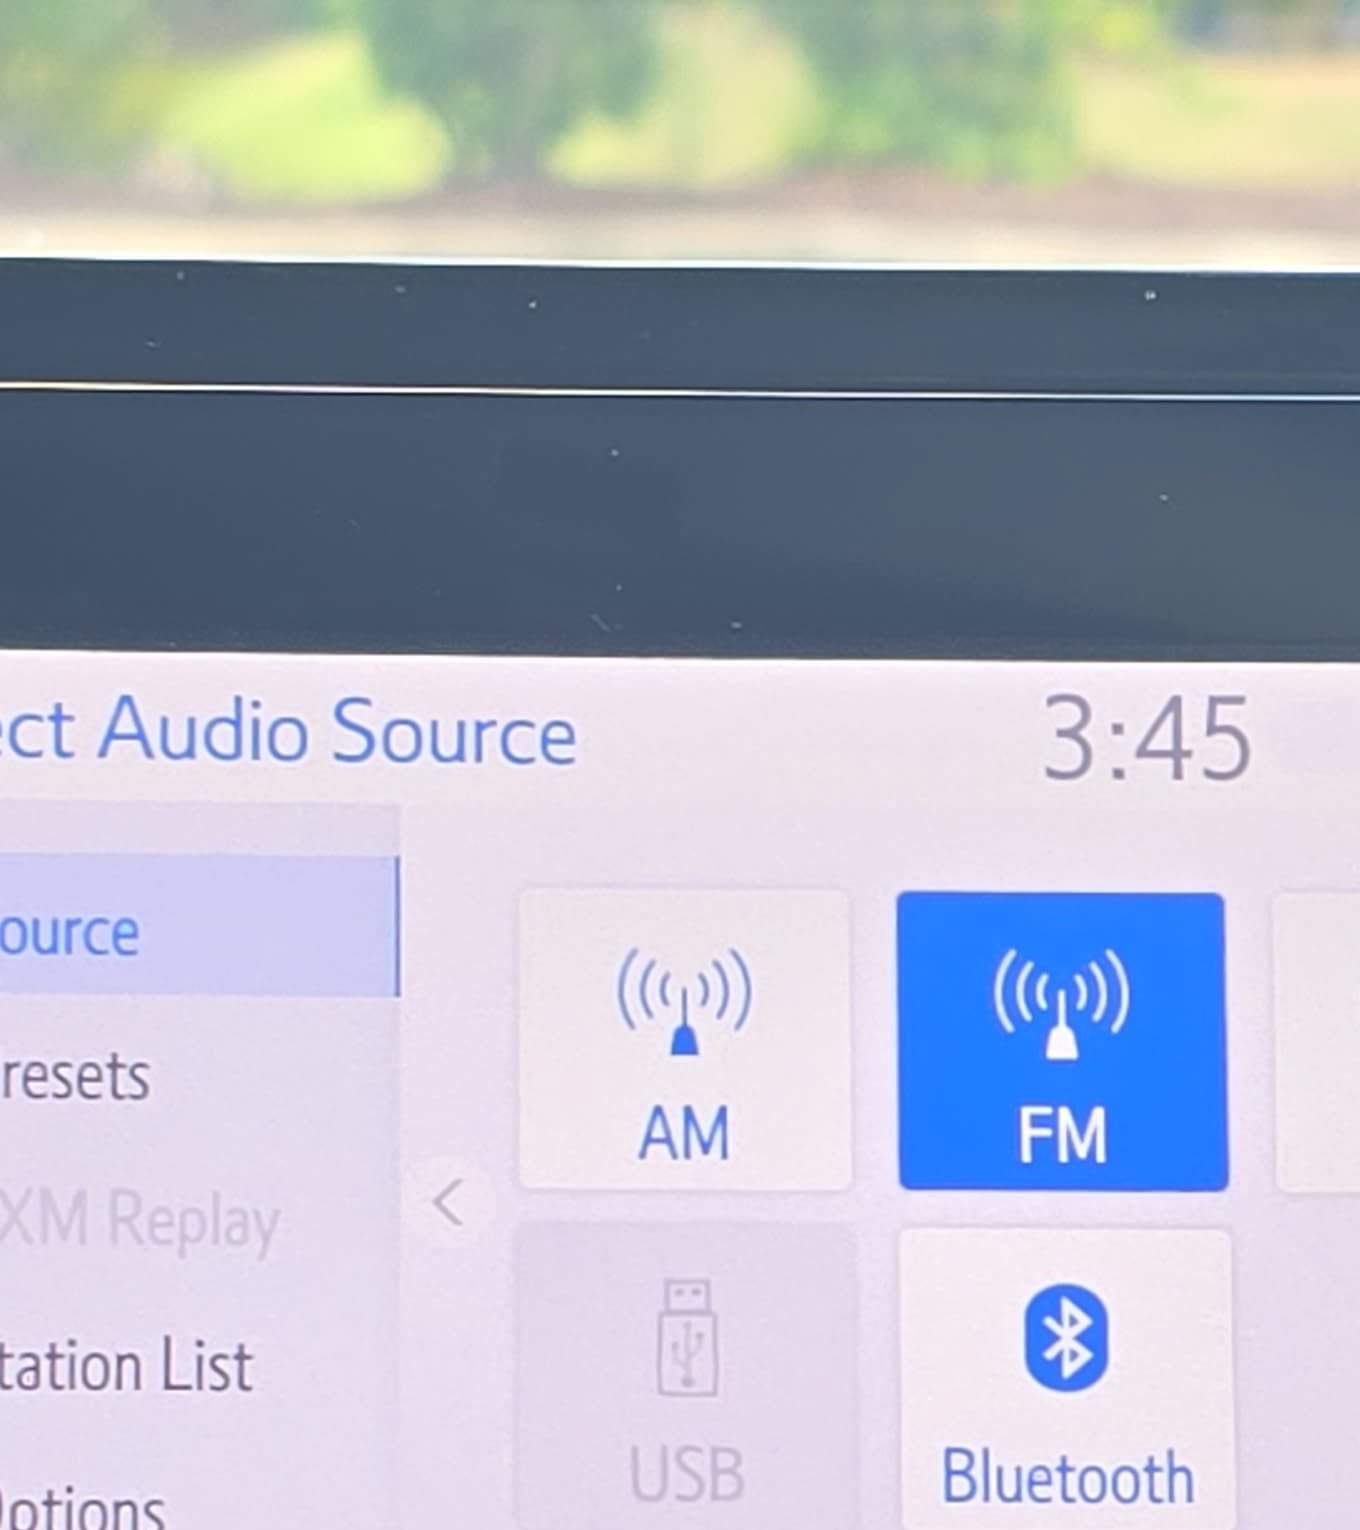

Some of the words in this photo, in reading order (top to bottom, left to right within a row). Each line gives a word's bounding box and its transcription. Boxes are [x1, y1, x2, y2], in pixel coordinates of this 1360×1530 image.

[97, 695, 309, 763] Audio
[332, 697, 577, 766] Source
[1044, 693, 1252, 782] 3:45
[638, 1104, 730, 1160] AM
[1018, 1106, 1108, 1164] FM
[110, 1190, 281, 1259] Replay
[162, 1336, 255, 1393] List
[629, 1444, 746, 1503] USB
[942, 1447, 1195, 1504] Bluetooth
